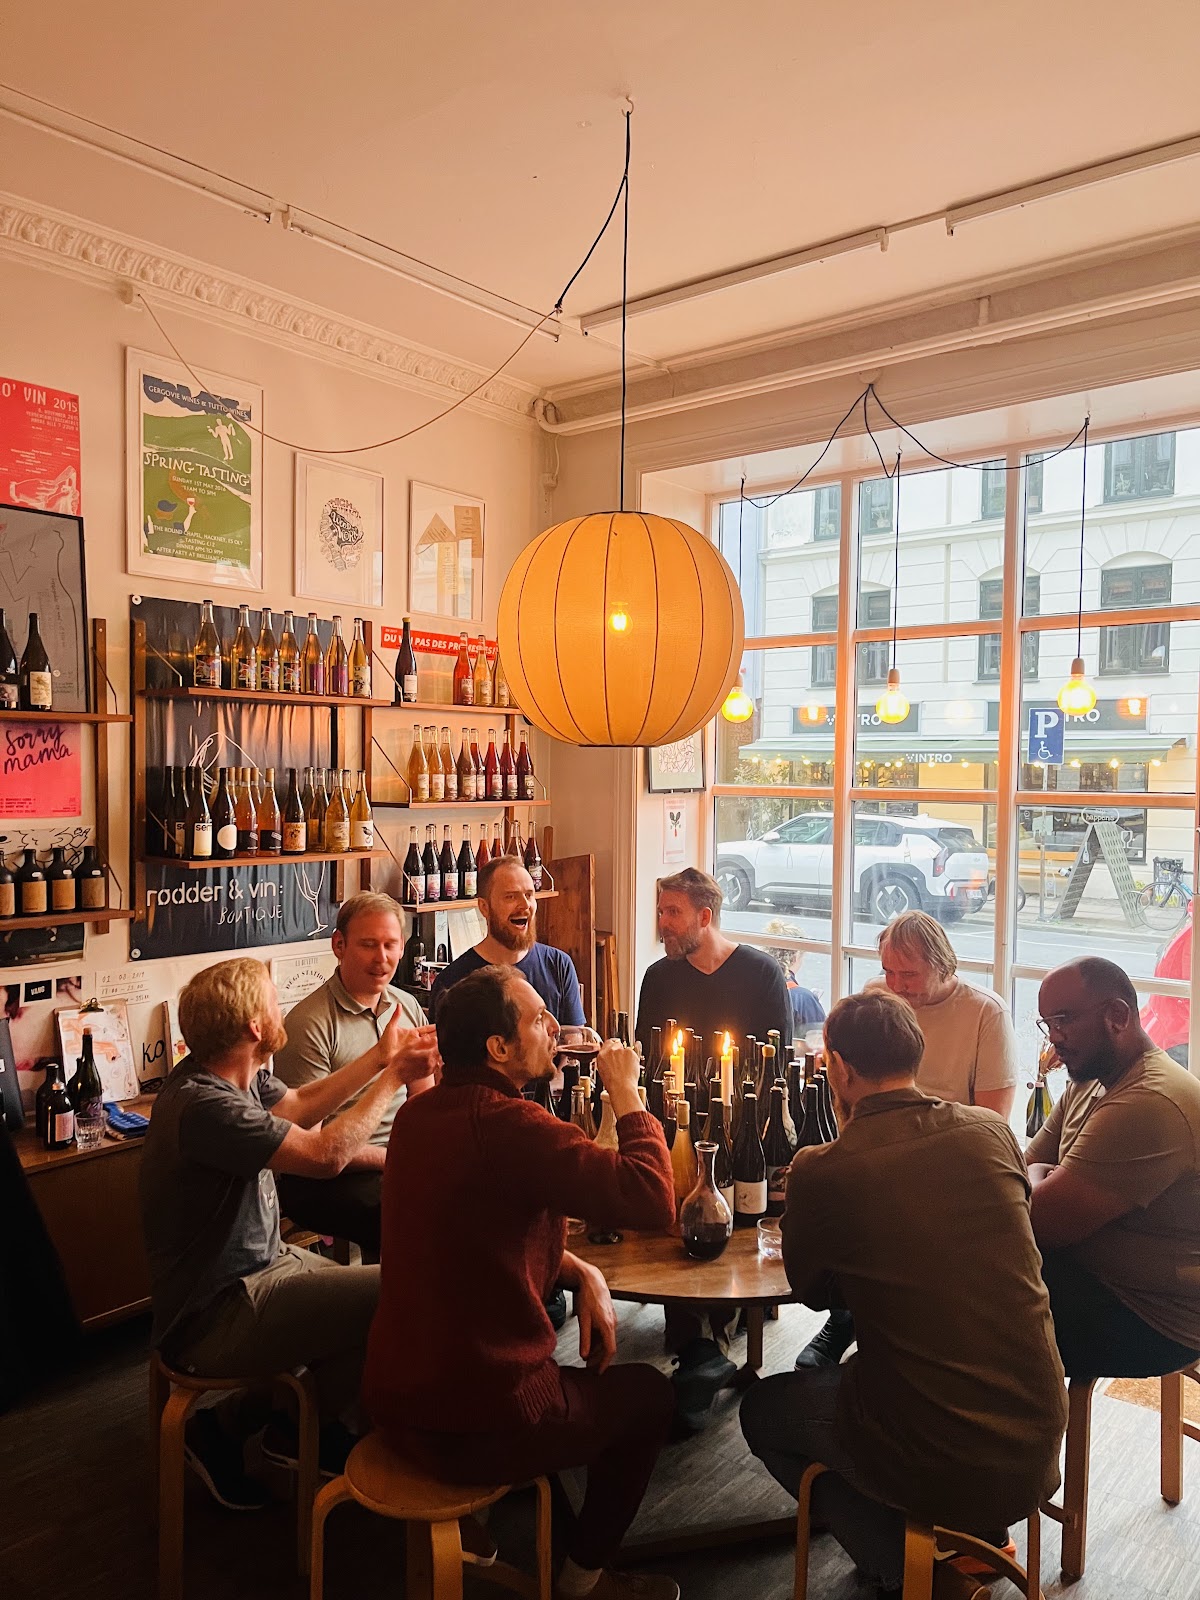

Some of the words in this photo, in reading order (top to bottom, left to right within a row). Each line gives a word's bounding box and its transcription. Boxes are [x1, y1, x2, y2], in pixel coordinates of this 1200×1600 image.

[24, 386, 46, 405] VIN
[53, 397, 78, 412] 2015
[148, 385, 180, 399] GERGOVIE
[181, 394, 200, 405] WINES
[144, 452, 194, 474] SPRING
[195, 463, 250, 487] TASTING
[172, 475, 193, 485] SUNDAY
[164, 527, 183, 535] ROUND
[176, 543, 194, 551] DINNER
[185, 538, 205, 546] TASTING
[156, 546, 171, 554] AFTER
[172, 549, 188, 557] PARTY
[383, 633, 397, 643] DU
[415, 638, 431, 647] PAS
[432, 640, 447, 650] DES
[1035, 711, 1059, 739] P
[147, 881, 223, 907] rødder
[229, 878, 244, 900] &
[217, 904, 283, 925] BOUTIQUE
